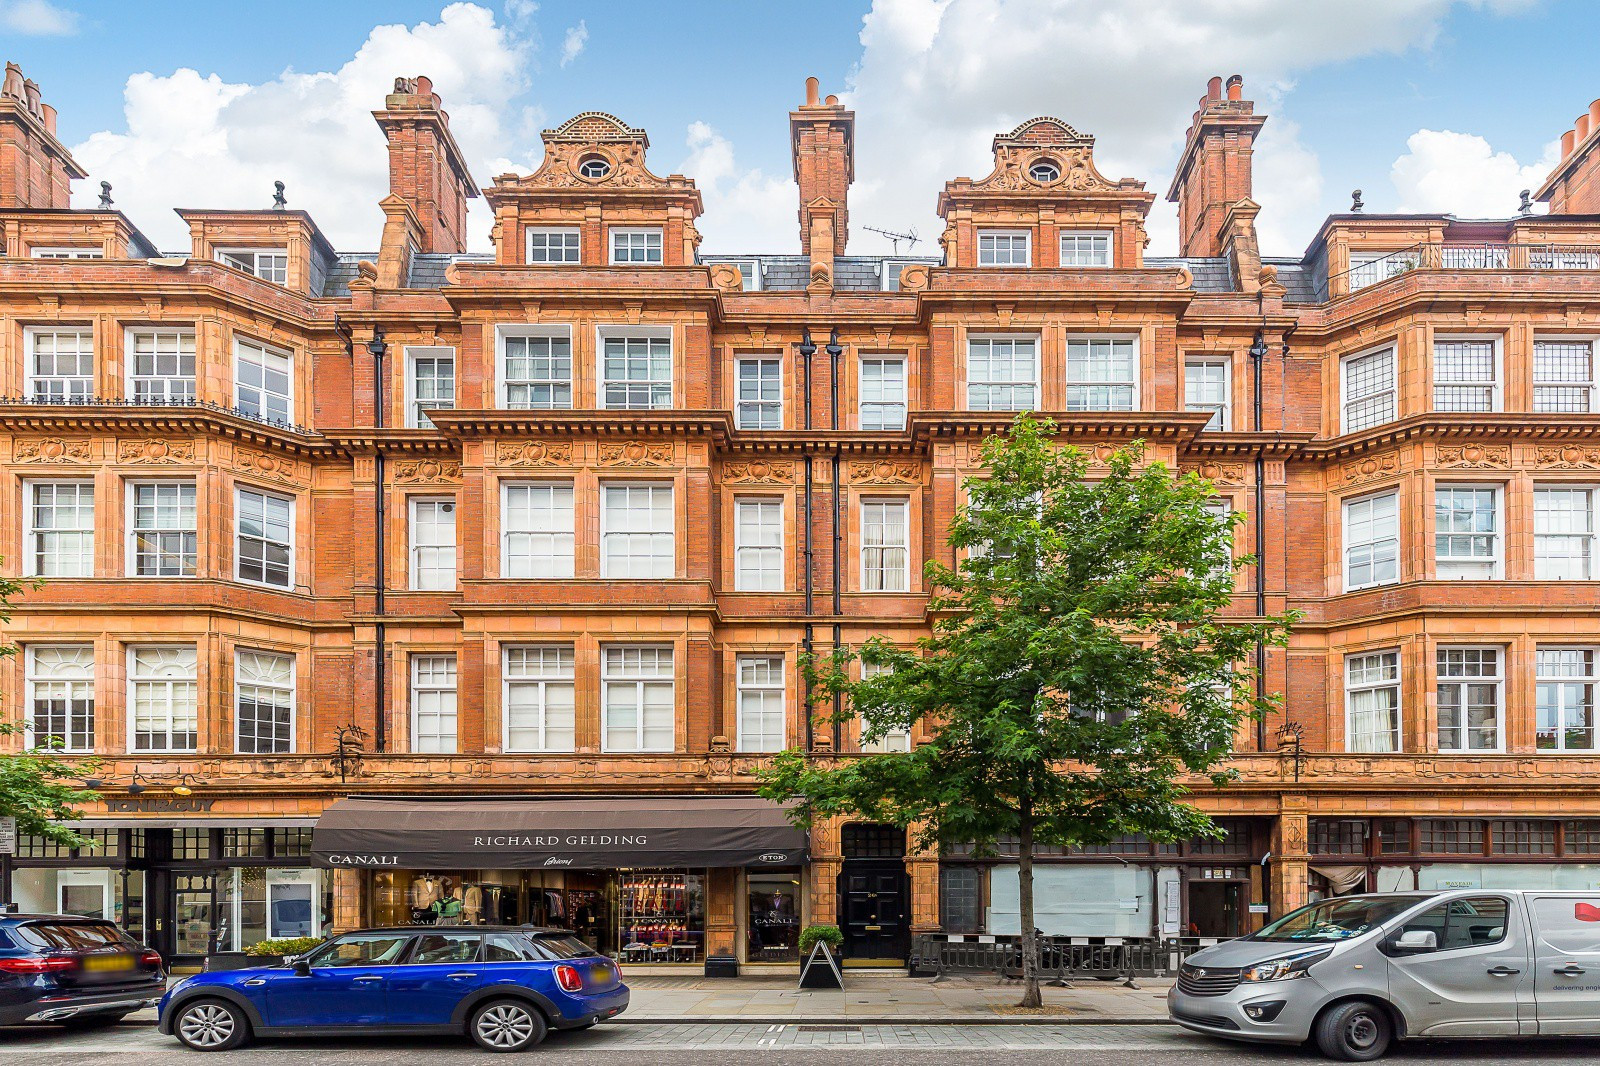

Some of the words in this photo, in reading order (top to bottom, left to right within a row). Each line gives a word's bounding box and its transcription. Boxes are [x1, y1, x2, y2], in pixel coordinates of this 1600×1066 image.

[105, 799, 215, 812] TONI&GUY
[474, 836, 559, 846] RICHARD
[566, 835, 647, 845] GELDING
[329, 855, 398, 865] CANALI
